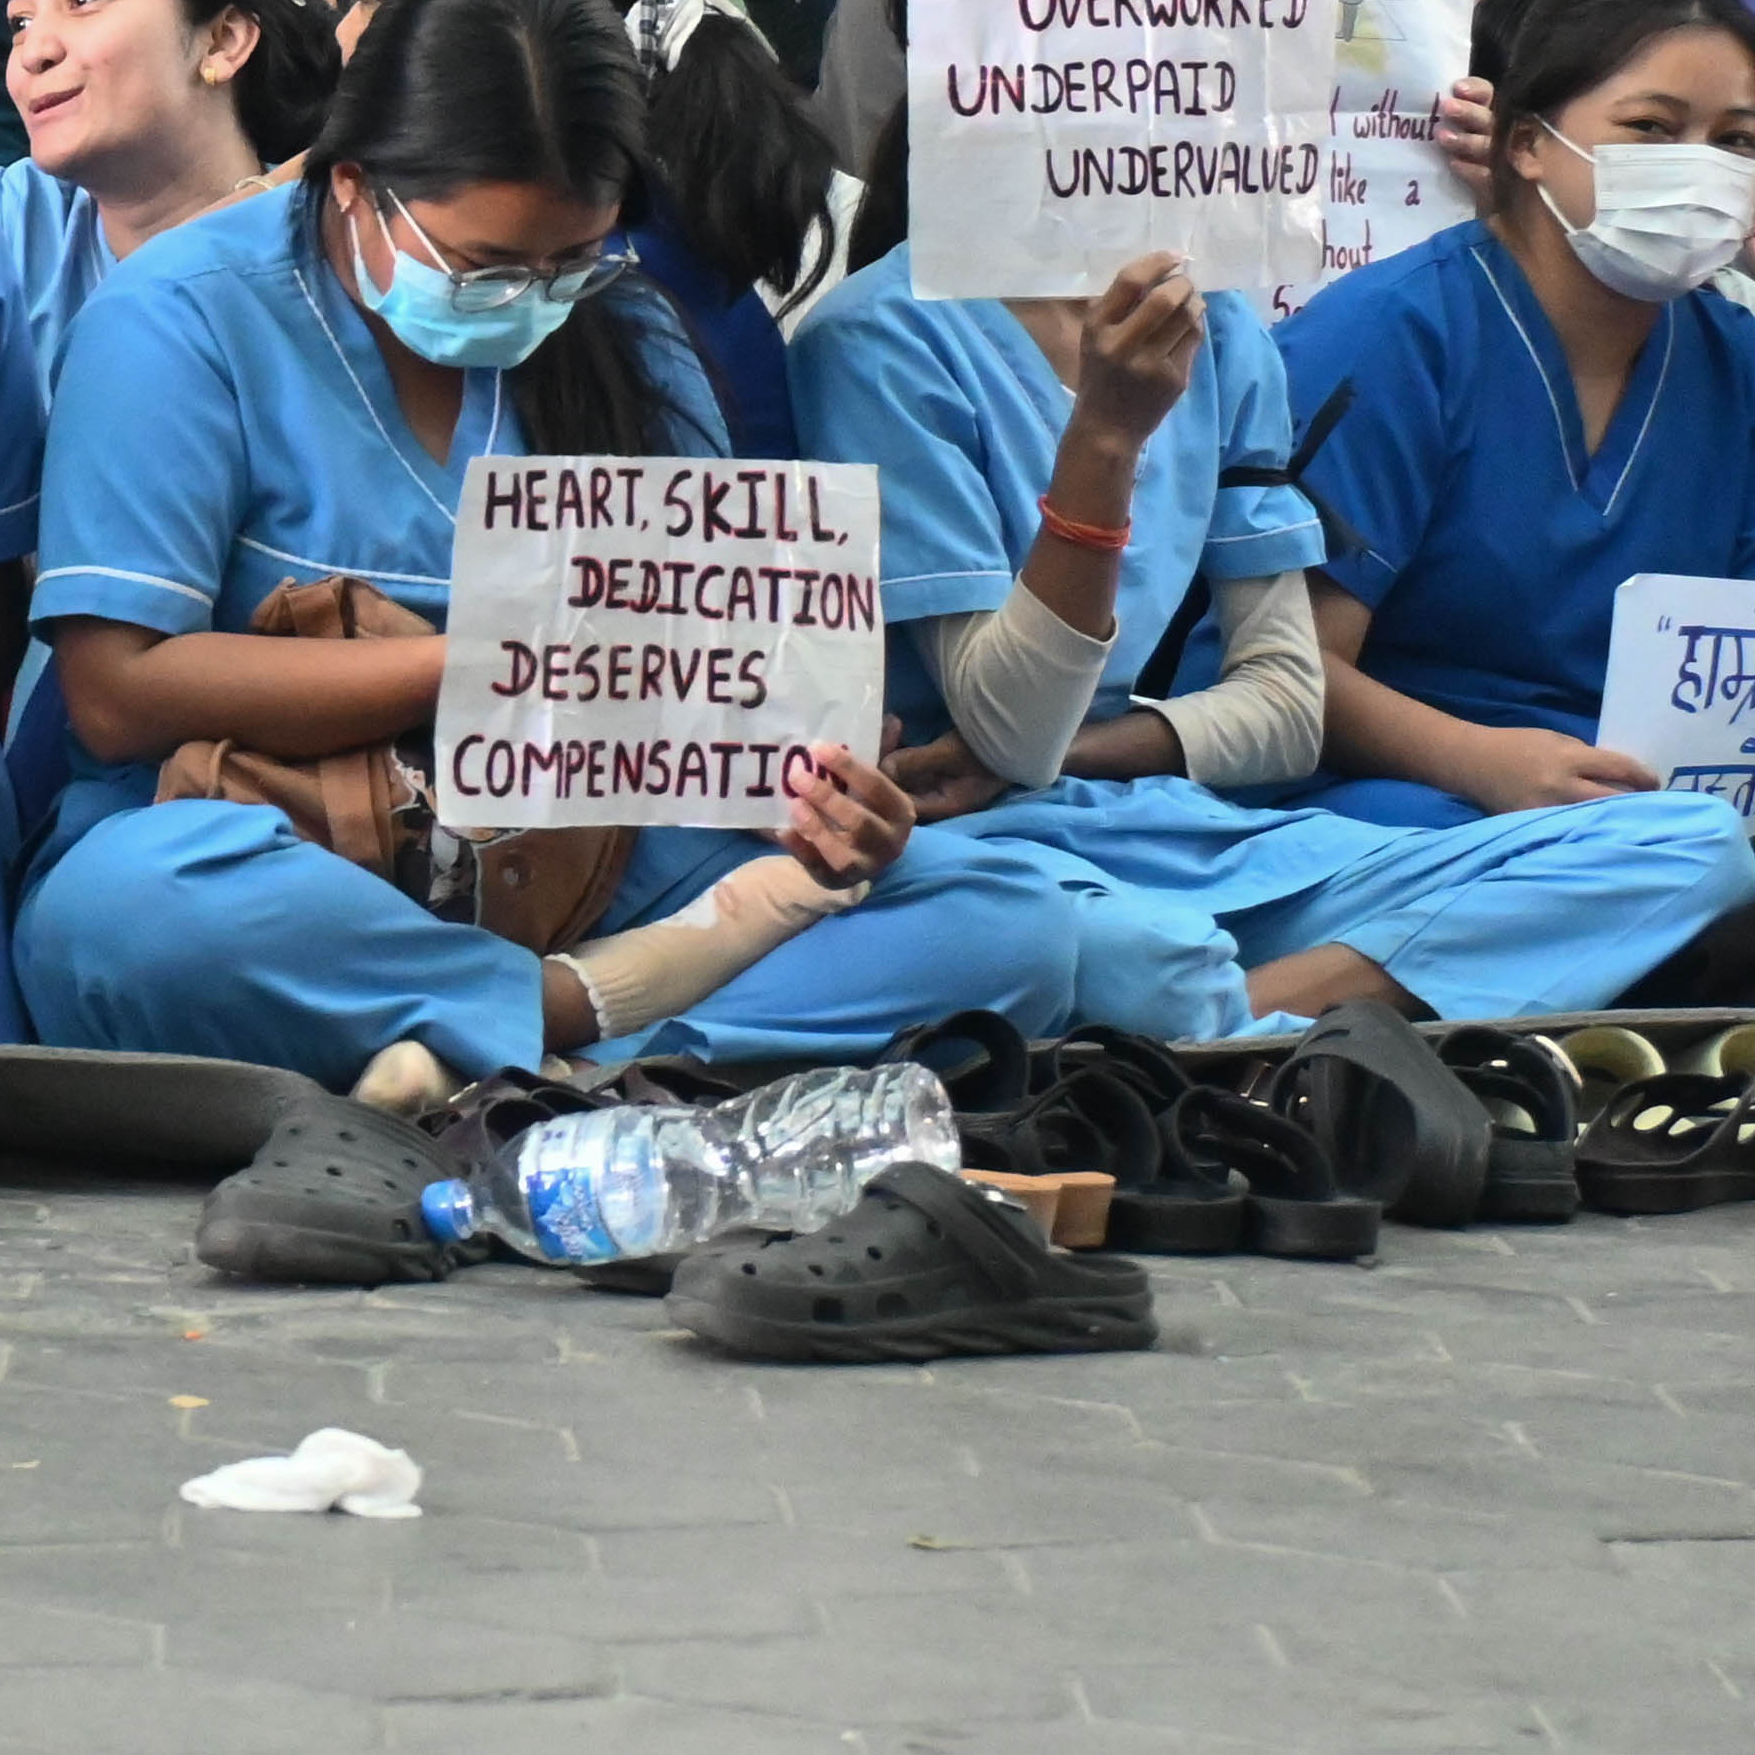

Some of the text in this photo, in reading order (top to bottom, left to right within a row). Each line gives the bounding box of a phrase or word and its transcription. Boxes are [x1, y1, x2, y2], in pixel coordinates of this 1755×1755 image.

[946, 58, 1237, 118] UNDERPAID
[1353, 87, 1441, 141] without
[1045, 139, 1320, 199] UNDERVALUED
[1330, 149, 1421, 207] like a
[484, 467, 850, 544] HEART, SKILL,
[567, 554, 876, 633] DEDICATION
[491, 639, 768, 710] DESERVES
